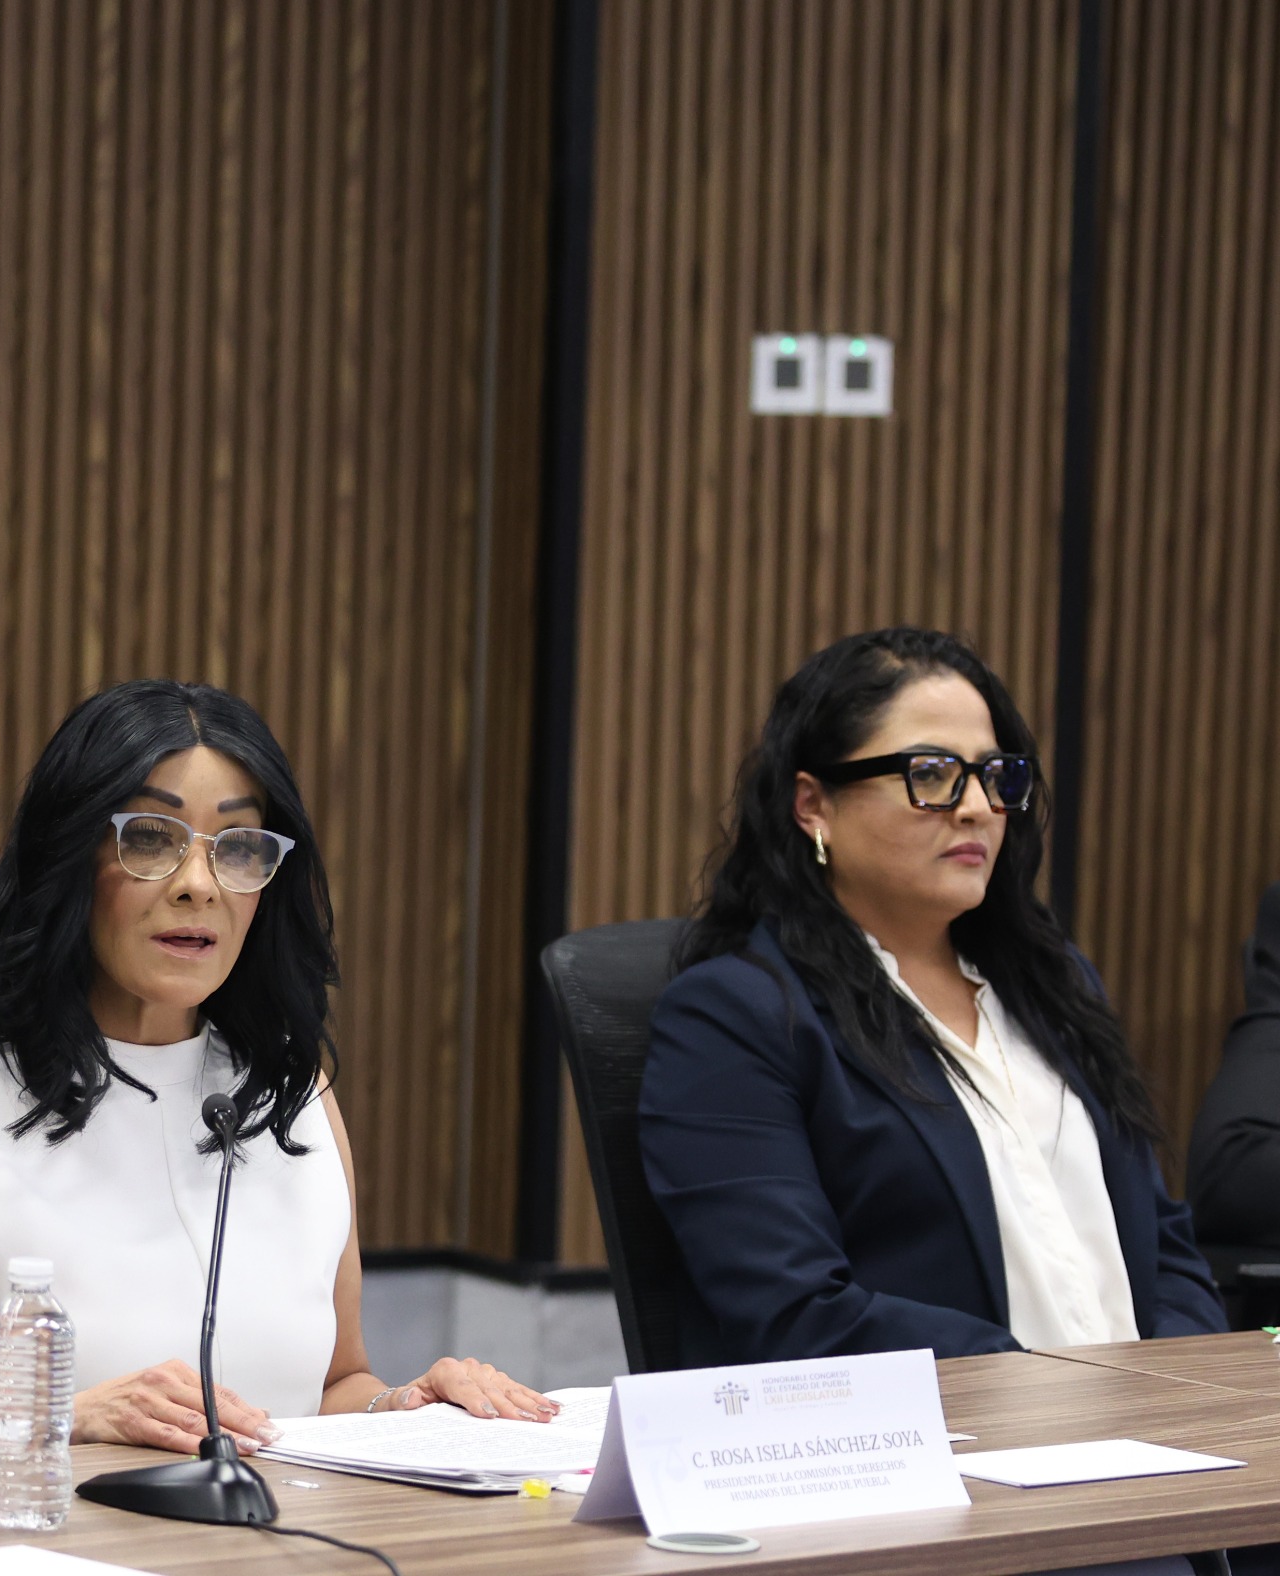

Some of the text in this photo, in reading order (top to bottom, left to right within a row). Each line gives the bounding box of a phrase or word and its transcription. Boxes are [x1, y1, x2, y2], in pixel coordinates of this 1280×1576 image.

[762, 1370, 850, 1385] HONORABLE CONGRESO
[763, 1378, 852, 1394] DEL ESTADO DE PUEBLA
[786, 1388, 853, 1404] LEGISLATURA
[692, 1429, 924, 1469] C. ROSA ISELA SÁNCHEZ SOYA
[704, 1459, 906, 1490] PRESIDENTA DE LA COMISIÓN DE DERECHOS
[730, 1476, 891, 1502] HUMANOS DEL ESTADO DE PUEBLA
